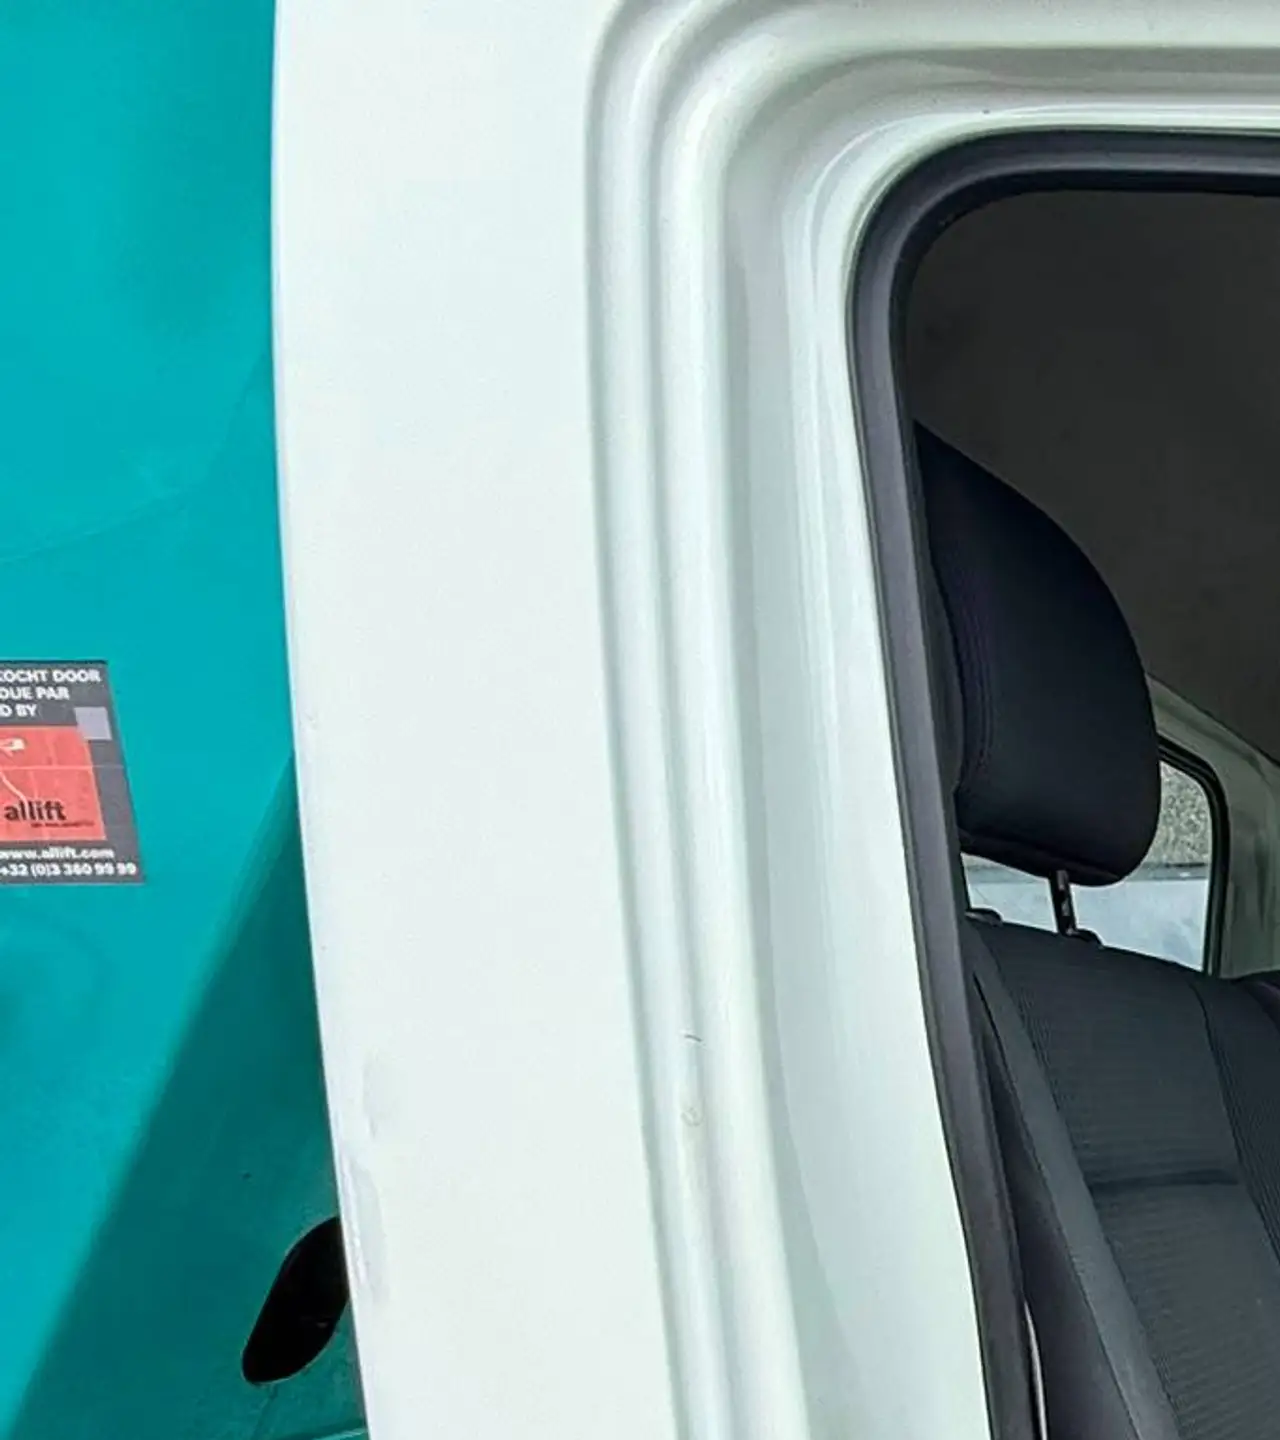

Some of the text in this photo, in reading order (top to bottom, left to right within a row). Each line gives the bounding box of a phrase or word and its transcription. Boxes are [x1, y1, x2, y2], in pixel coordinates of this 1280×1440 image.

[52, 668, 101, 683] DOOR
[35, 685, 70, 701] PAR
[15, 703, 38, 718] BY
[4, 800, 67, 821] allift
